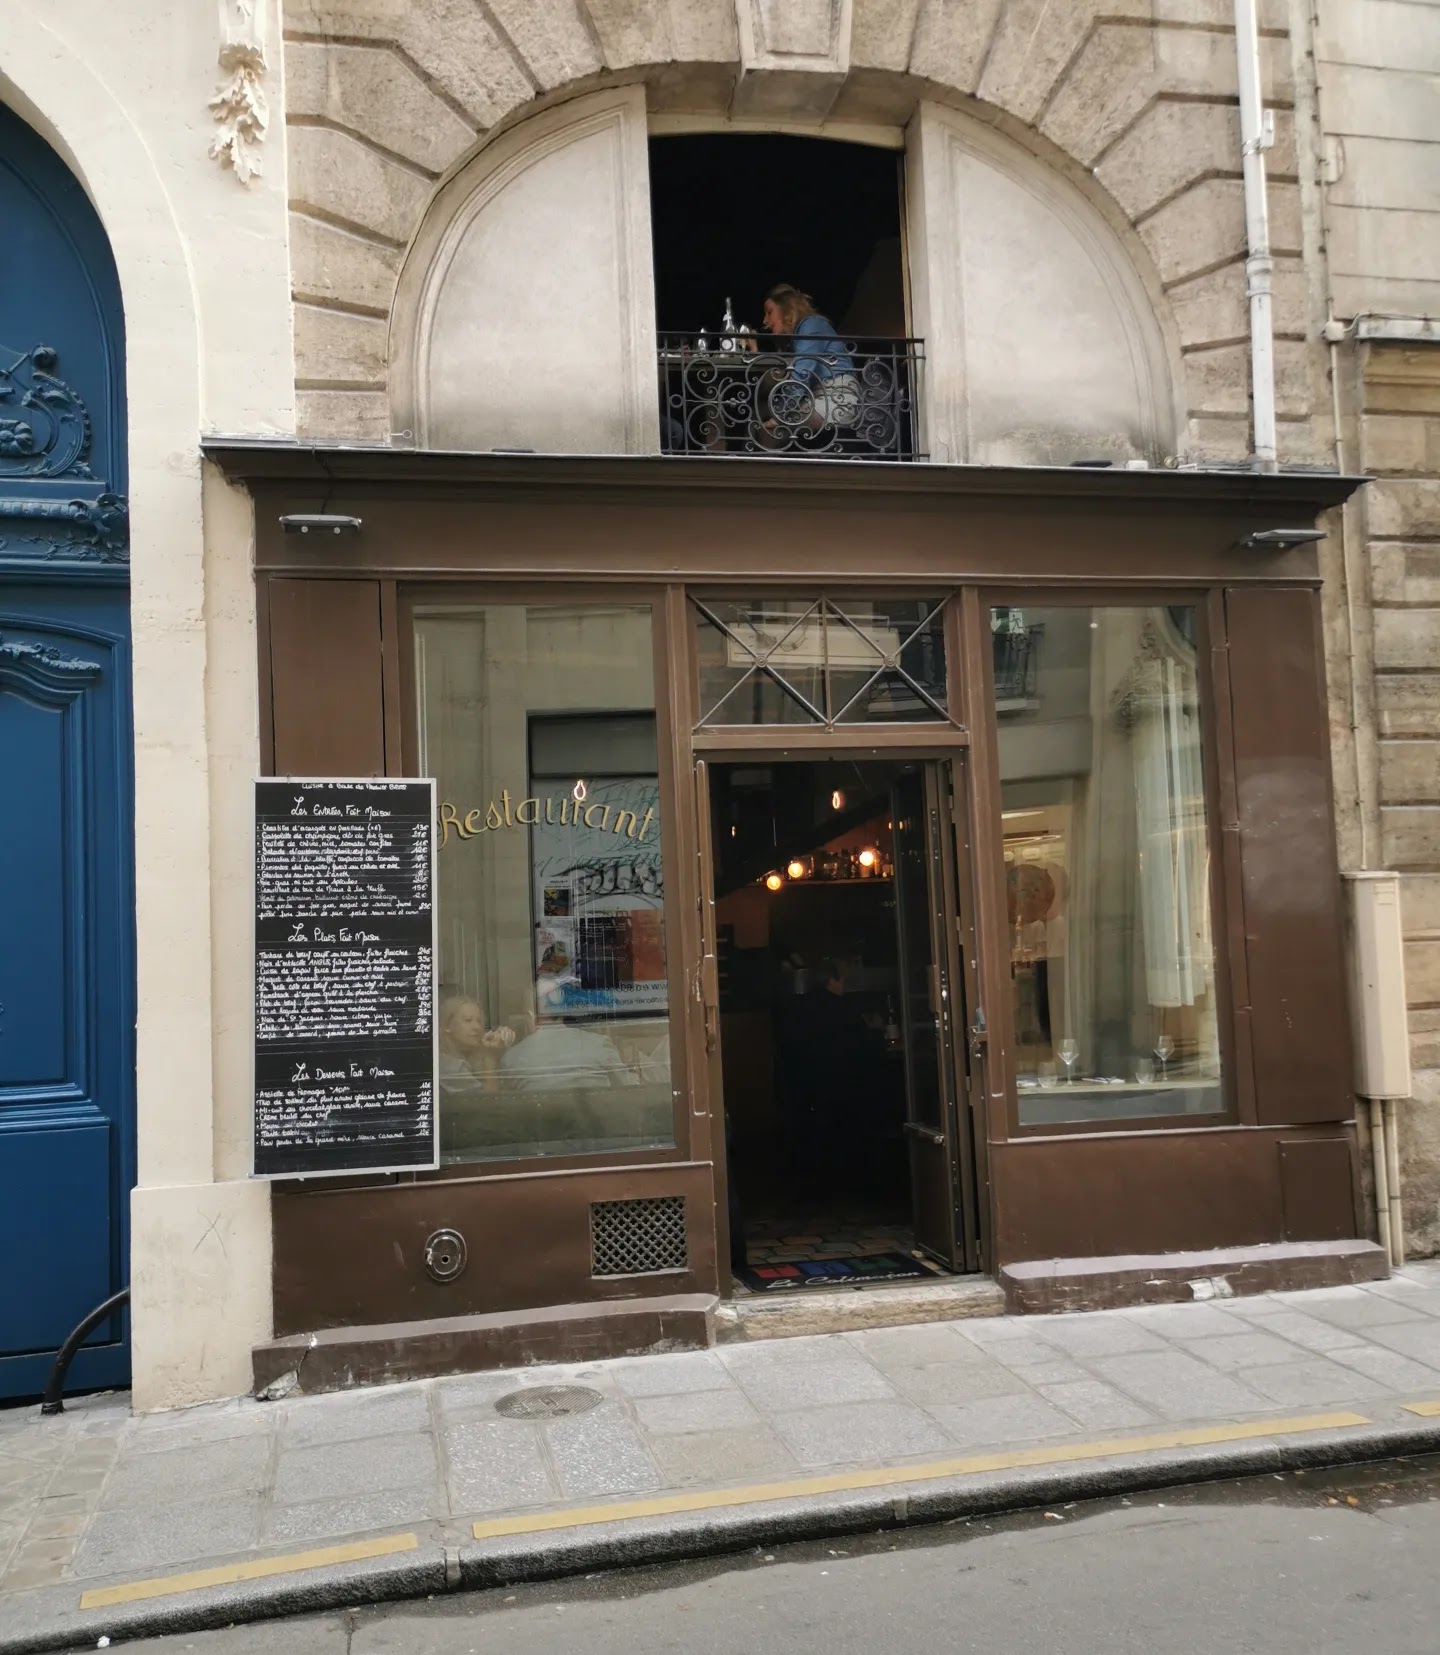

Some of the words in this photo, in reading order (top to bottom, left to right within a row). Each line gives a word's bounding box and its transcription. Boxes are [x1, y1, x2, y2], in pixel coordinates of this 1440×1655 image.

[290, 796, 307, 816] Les
[346, 805, 361, 816] Fait
[437, 788, 653, 851] Restaurant
[287, 923, 308, 942] Les
[339, 928, 353, 942] Fait
[290, 1062, 310, 1083] Les
[350, 1063, 364, 1078] Fait
[368, 1066, 396, 1080] Maison
[766, 1278, 801, 1289] Le
